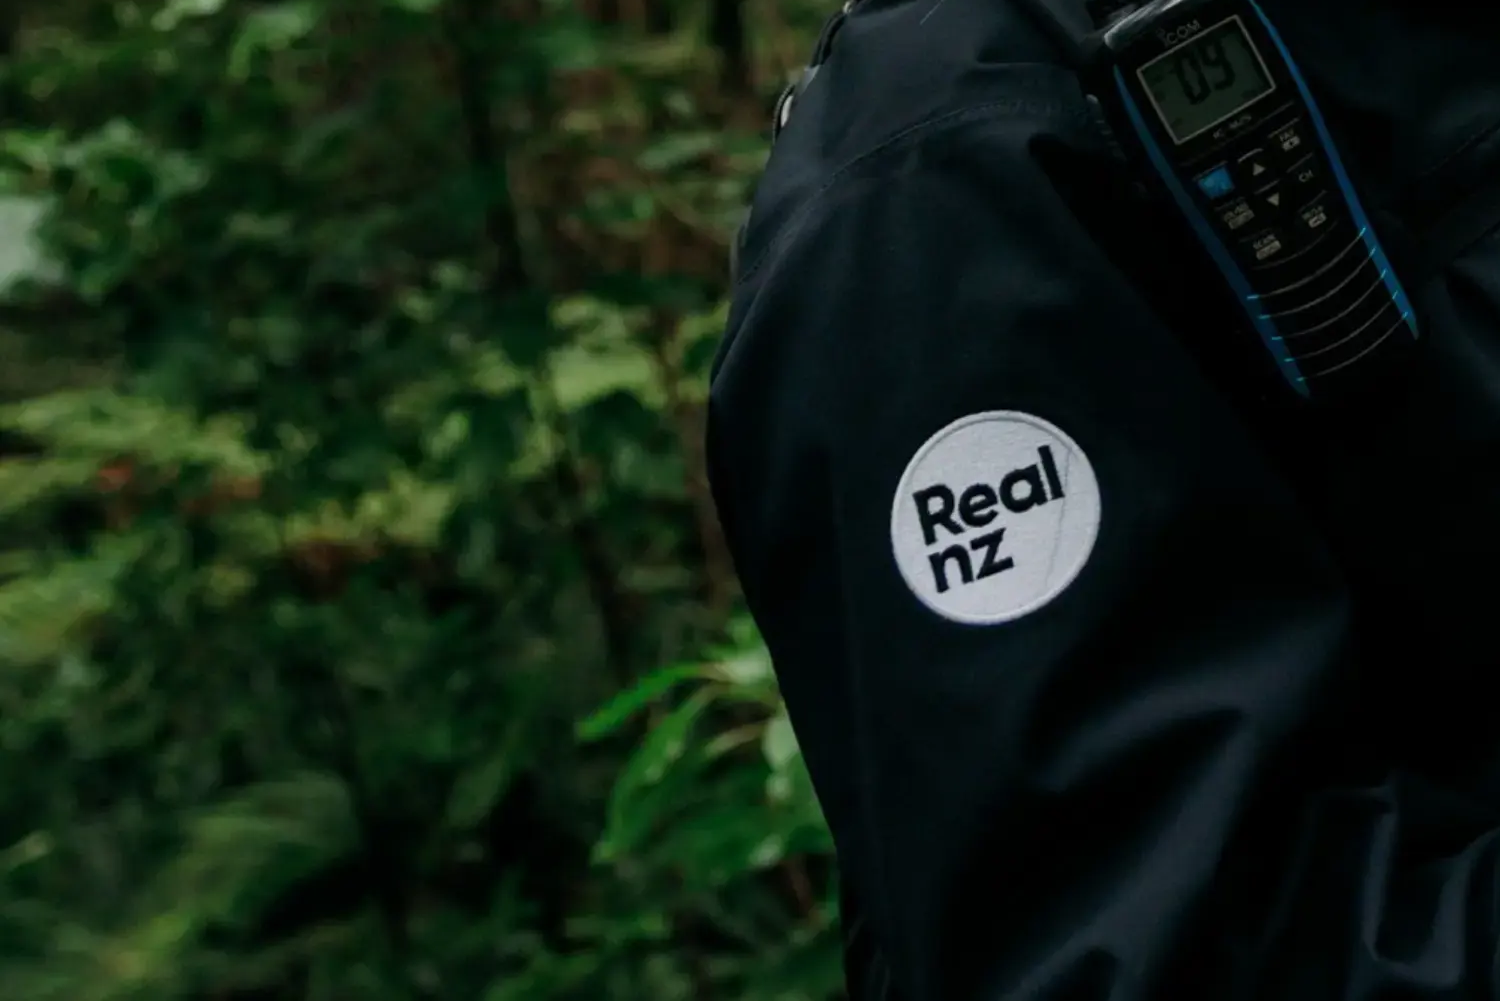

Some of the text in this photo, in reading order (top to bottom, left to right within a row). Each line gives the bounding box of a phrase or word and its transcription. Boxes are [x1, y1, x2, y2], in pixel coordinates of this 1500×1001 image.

[1175, 40, 1235, 105] 09
[913, 445, 1066, 546] Real
[928, 527, 1015, 593] nz
